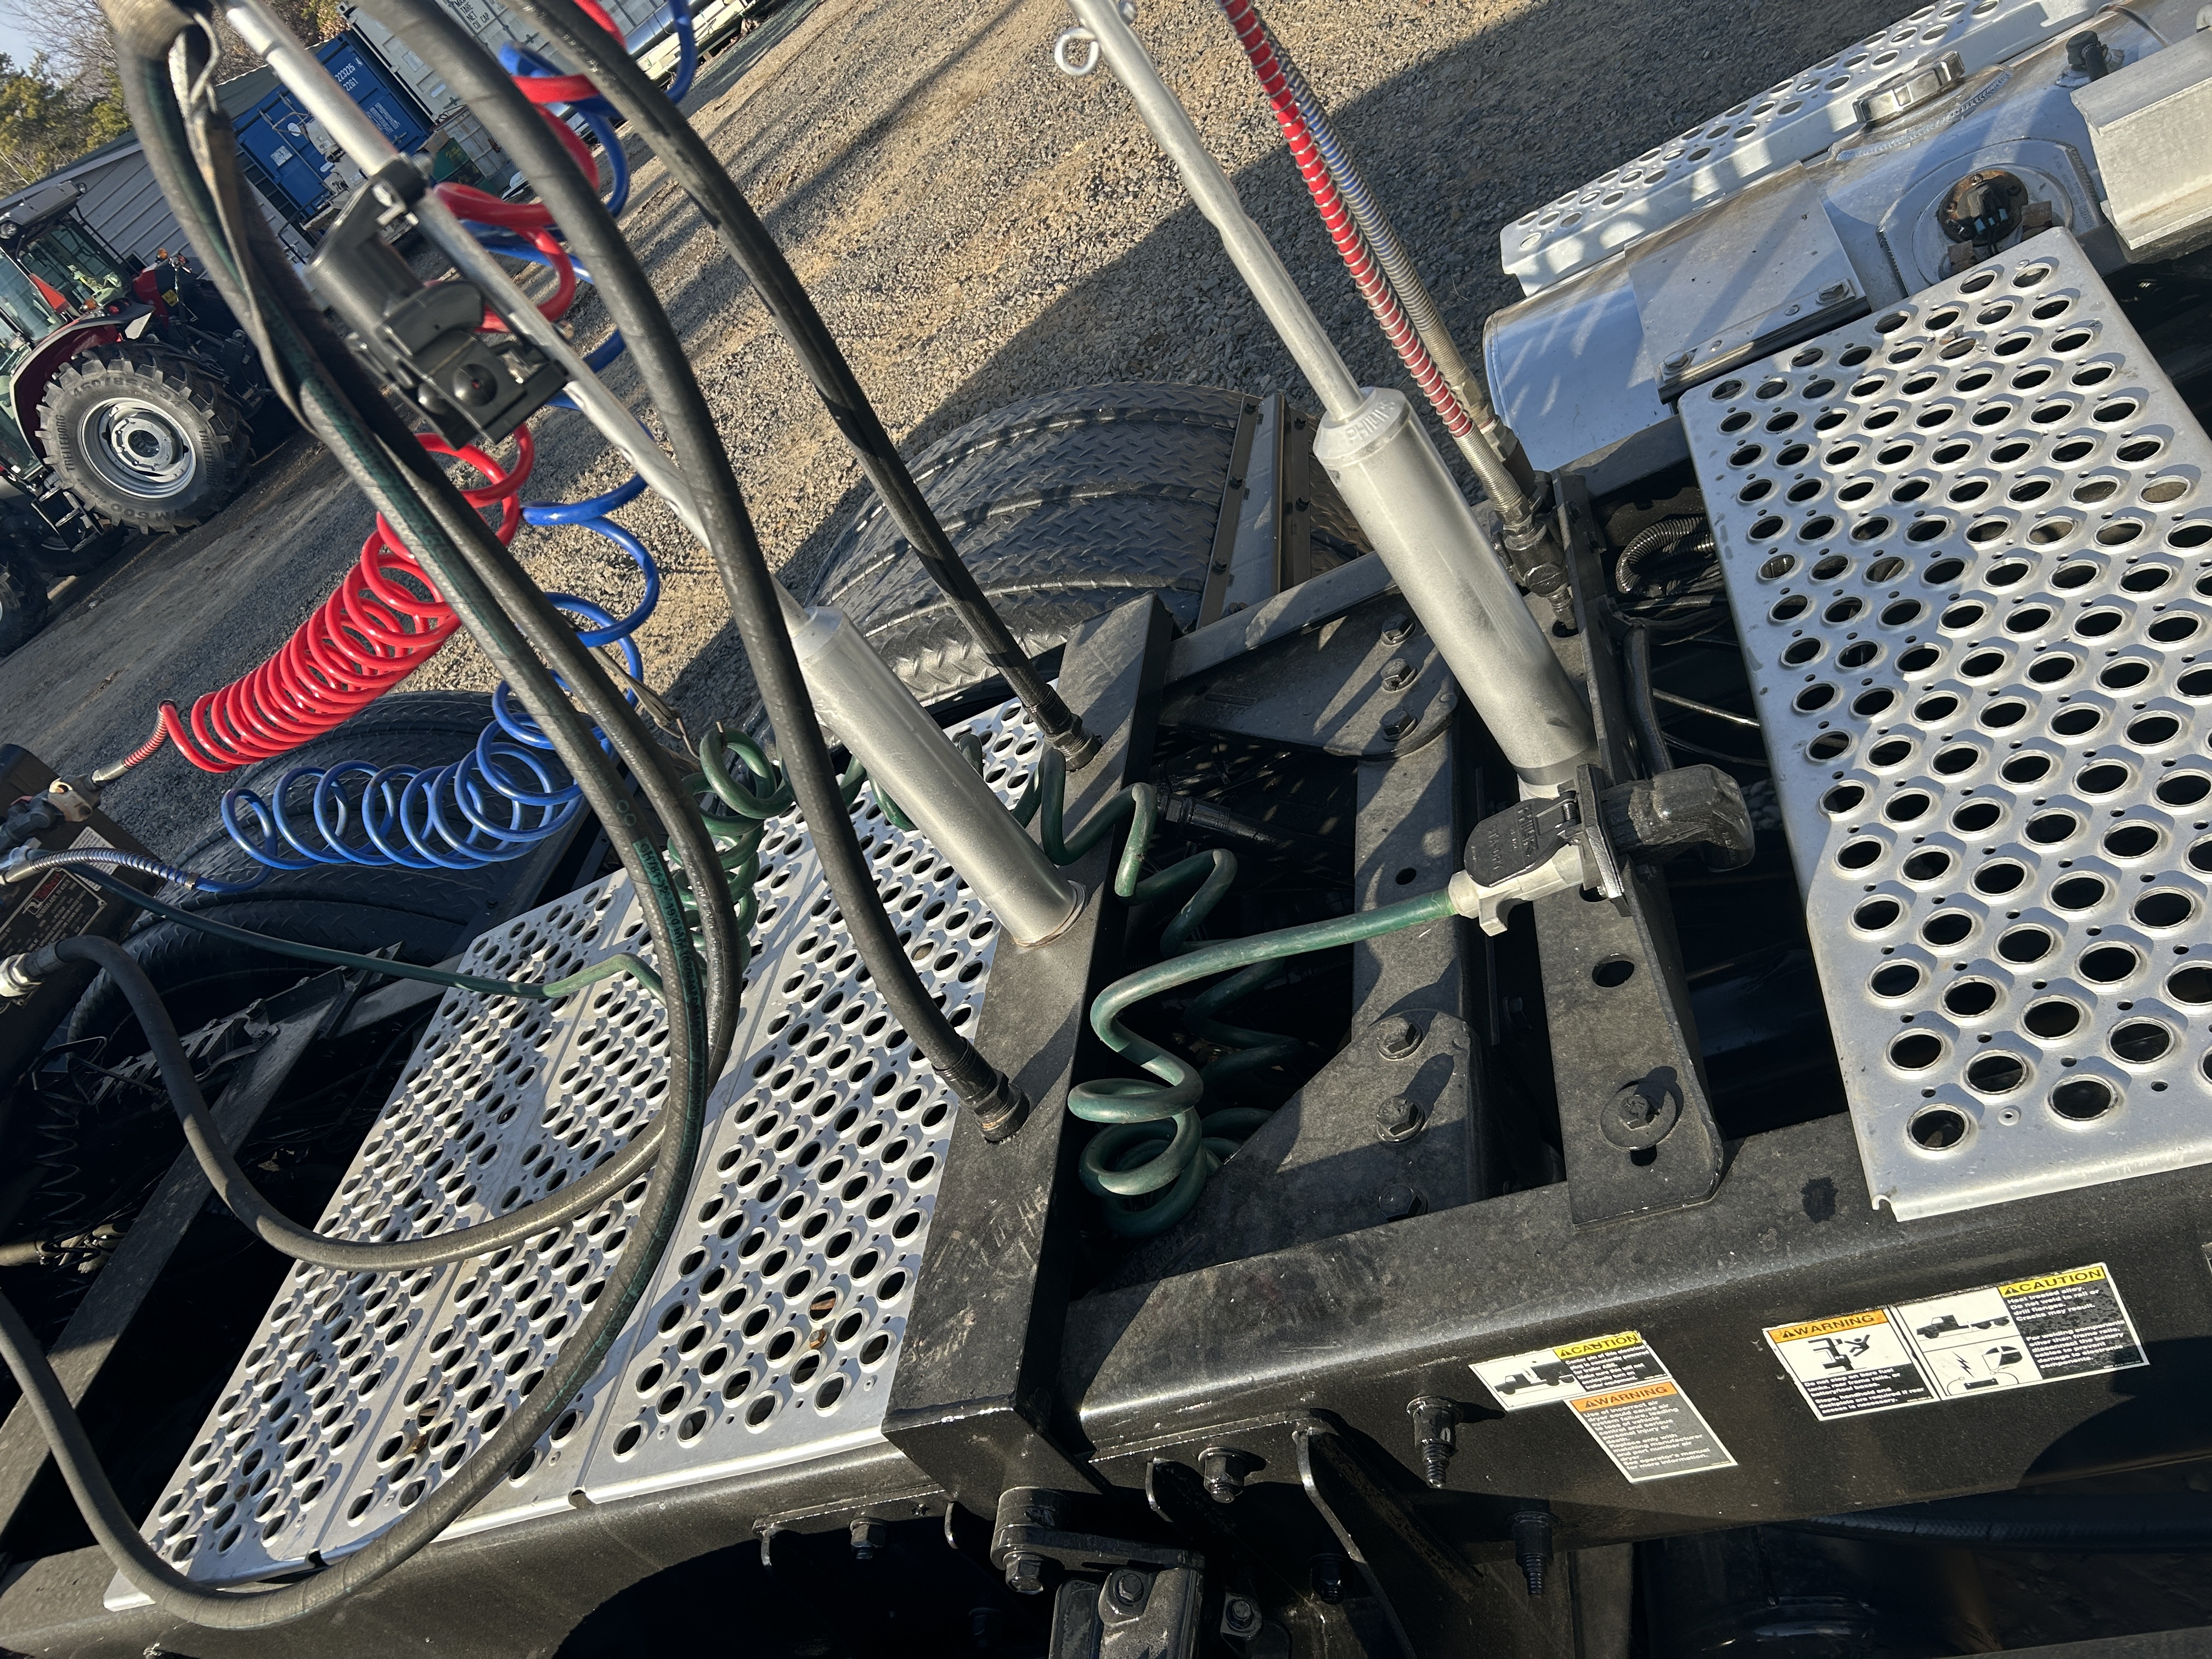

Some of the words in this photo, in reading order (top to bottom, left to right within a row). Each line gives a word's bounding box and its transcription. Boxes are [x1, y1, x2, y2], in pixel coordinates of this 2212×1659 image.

[460, 2, 474, 14] TARE
[466, 10, 477, 23] NET
[472, 20, 481, 30] CU
[480, 12, 490, 23] CAP
[334, 63, 356, 82] 223225
[343, 77, 359, 92] 22G1
[55, 414, 75, 472] TRELLEBORG
[199, 428, 218, 487] TRELLEBORG
[639, 840, 670, 896] GH781-12
[36, 872, 63, 899] Talbert
[2017, 1268, 2102, 1293] CAUTION
[2006, 1296, 2028, 1304] Heat
[2028, 1289, 2060, 1300] treated
[2060, 1284, 2085, 1294] alloy.
[2023, 1300, 2040, 1308] not
[2039, 1295, 2062, 1305] weld
[2073, 1290, 2089, 1298] rail
[2012, 1308, 2031, 1316] drill
[2030, 1301, 2067, 1313] flanges.
[2015, 1311, 2047, 1322] Cracks
[2047, 1308, 2067, 1317] may
[2067, 1302, 2096, 1312] result.
[1792, 1314, 1876, 1335] WARNING
[2040, 1328, 2074, 1340] welding
[2074, 1319, 2125, 1333] components
[1569, 1334, 1639, 1354] CAUTION
[2028, 1339, 2052, 1347] other
[2051, 1335, 2072, 1343] than
[2072, 1330, 2098, 1339] frame
[2098, 1326, 2120, 1335] rails,
[2030, 1340, 2079, 1353] disconnect
[2093, 1331, 2125, 1342] battery
[2033, 1348, 2062, 1358] cables
[2073, 1341, 2107, 1351] prevent
[2036, 1353, 2071, 1364] damage
[2080, 1344, 2124, 1356] electronic
[2039, 1355, 2094, 1370] components.
[1807, 1384, 1831, 1392] tanks,
[1847, 1377, 1871, 1385] frame
[1809, 1386, 1854, 1398] battery/tool
[1853, 1381, 1881, 1390] boxes.
[1593, 1386, 1668, 1406] WARNING
[1814, 1396, 1840, 1404] Steps,
[1838, 1389, 1876, 1400] handhold
[1817, 1398, 1855, 1409] deckplate
[1867, 1391, 1902, 1401] required
[1586, 1414, 1610, 1423] dryer
[1607, 1410, 1633, 1418] could
[1632, 1406, 1658, 1414] cause
[1609, 1402, 1647, 1413] incorrect
[1820, 1406, 1848, 1414] access
[1856, 1397, 1899, 1408] necessary.
[1590, 1418, 1621, 1427] system
[1619, 1413, 1649, 1421] failure,
[1647, 1407, 1680, 1417] leading
[1630, 1415, 1661, 1424] vehicle
[1597, 1427, 1627, 1436] control
[1642, 1418, 1674, 1427] serious
[1601, 1430, 1637, 1440] personal
[1635, 1426, 1661, 1435] injury
[1604, 1436, 1631, 1444] death.
[1608, 1439, 1642, 1449] Replace
[1612, 1443, 1650, 1453] matching
[1649, 1433, 1705, 1447] manufacturer
[1648, 1442, 1681, 1452] number
[1638, 1452, 1680, 1464] operator's
[1679, 1447, 1711, 1456] manual
[1660, 1453, 1709, 1465] information.
